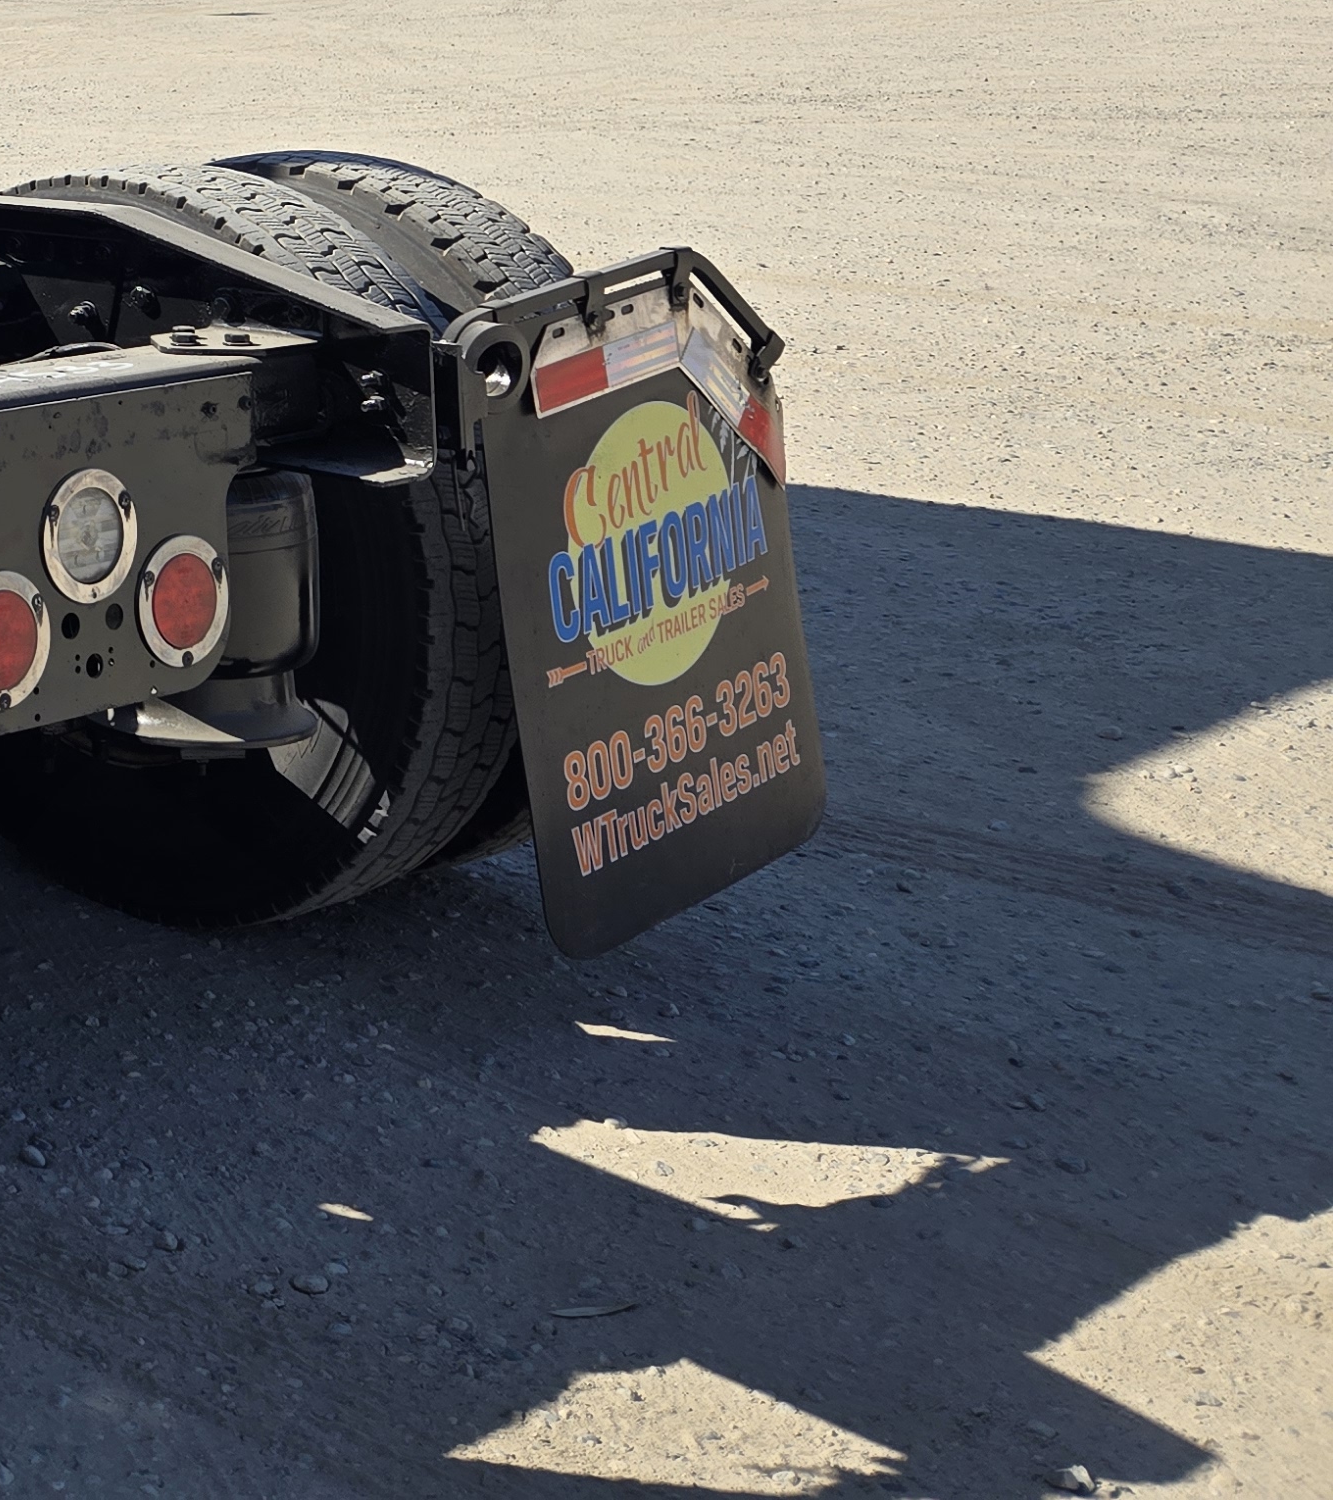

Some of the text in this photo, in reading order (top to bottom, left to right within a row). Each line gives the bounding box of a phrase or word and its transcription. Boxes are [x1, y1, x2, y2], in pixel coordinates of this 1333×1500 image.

[563, 390, 708, 550] Central
[548, 474, 768, 643] CALIFORNIA
[586, 583, 746, 675] TRUCK and TRAILER SALES
[563, 651, 791, 811] 800-366-3263
[571, 719, 800, 877] WTruckSales.net
